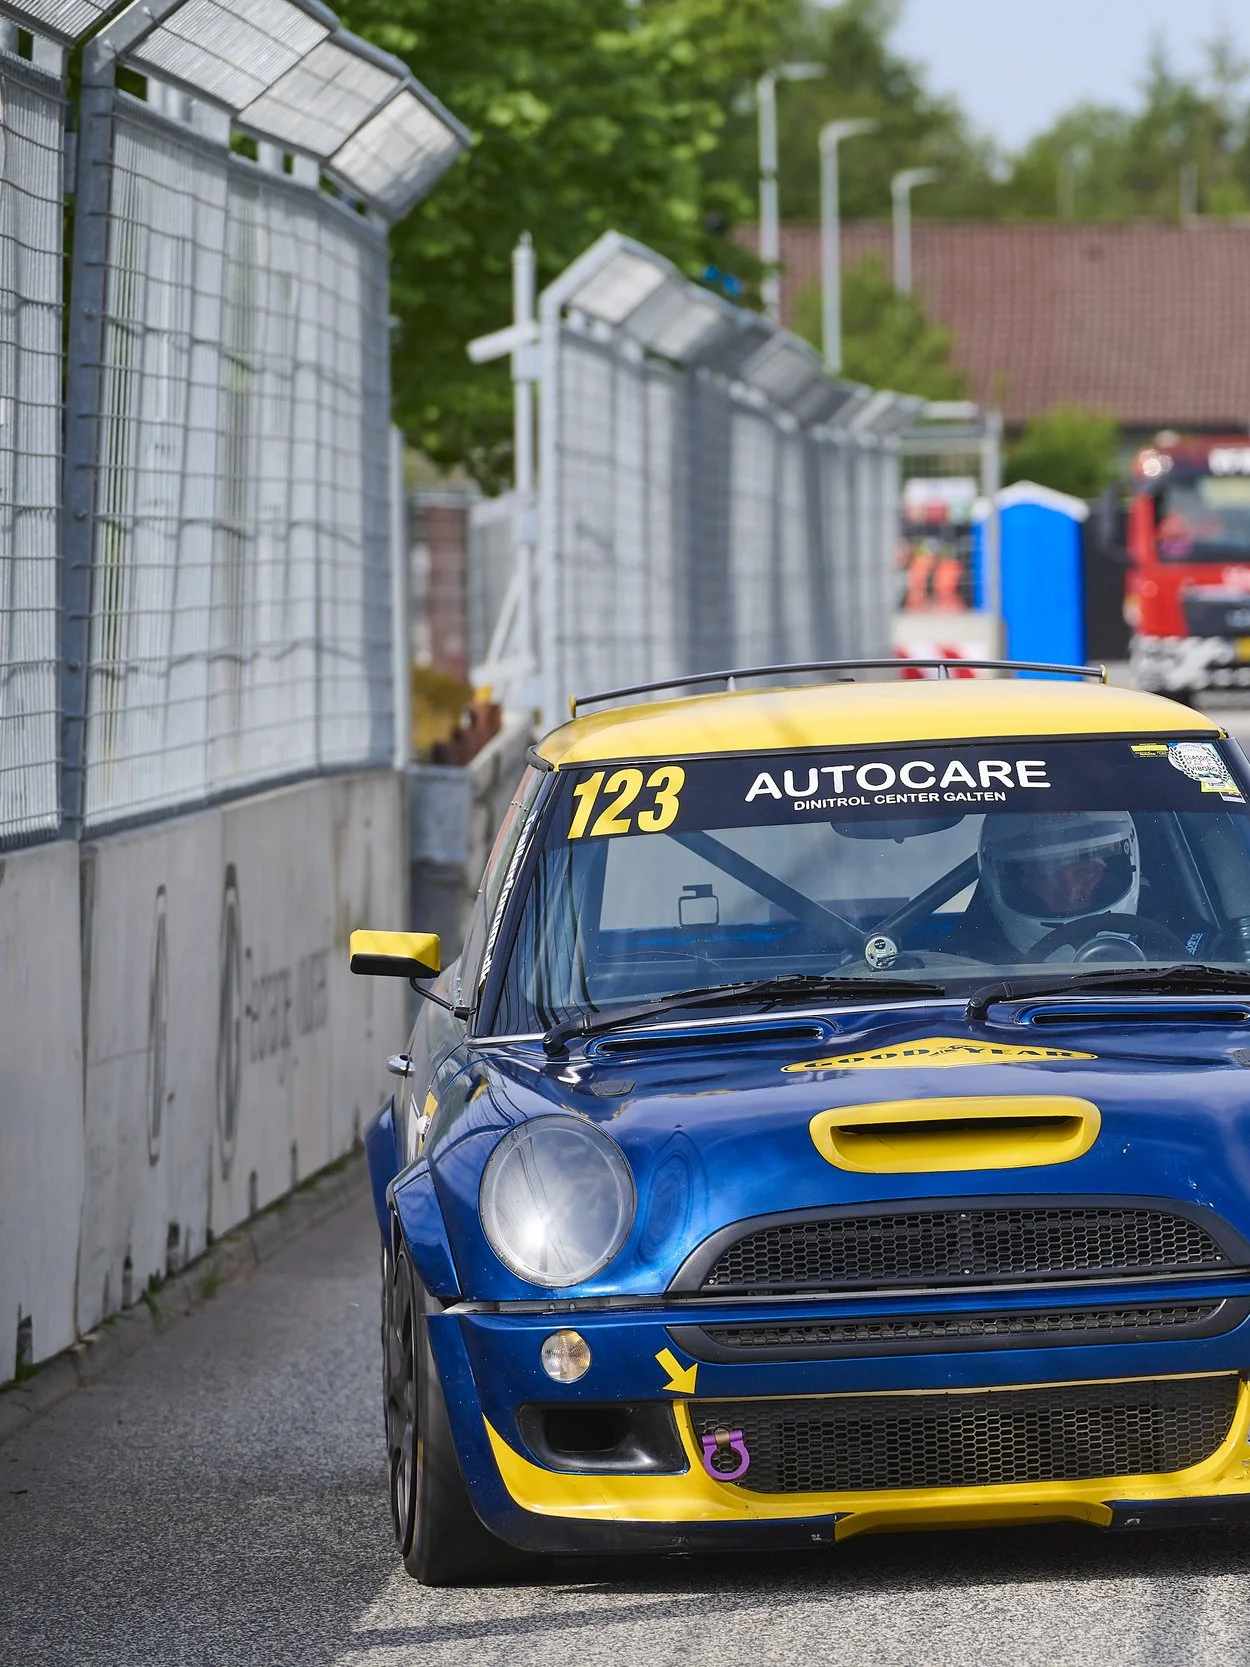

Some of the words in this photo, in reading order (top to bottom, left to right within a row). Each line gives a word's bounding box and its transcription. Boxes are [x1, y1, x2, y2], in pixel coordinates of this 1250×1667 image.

[567, 765, 687, 841] 123
[744, 760, 1053, 803] AUTOCARE
[792, 795, 871, 811] DINITROL
[873, 792, 940, 805] CENTER
[943, 791, 1007, 803] GALTEN
